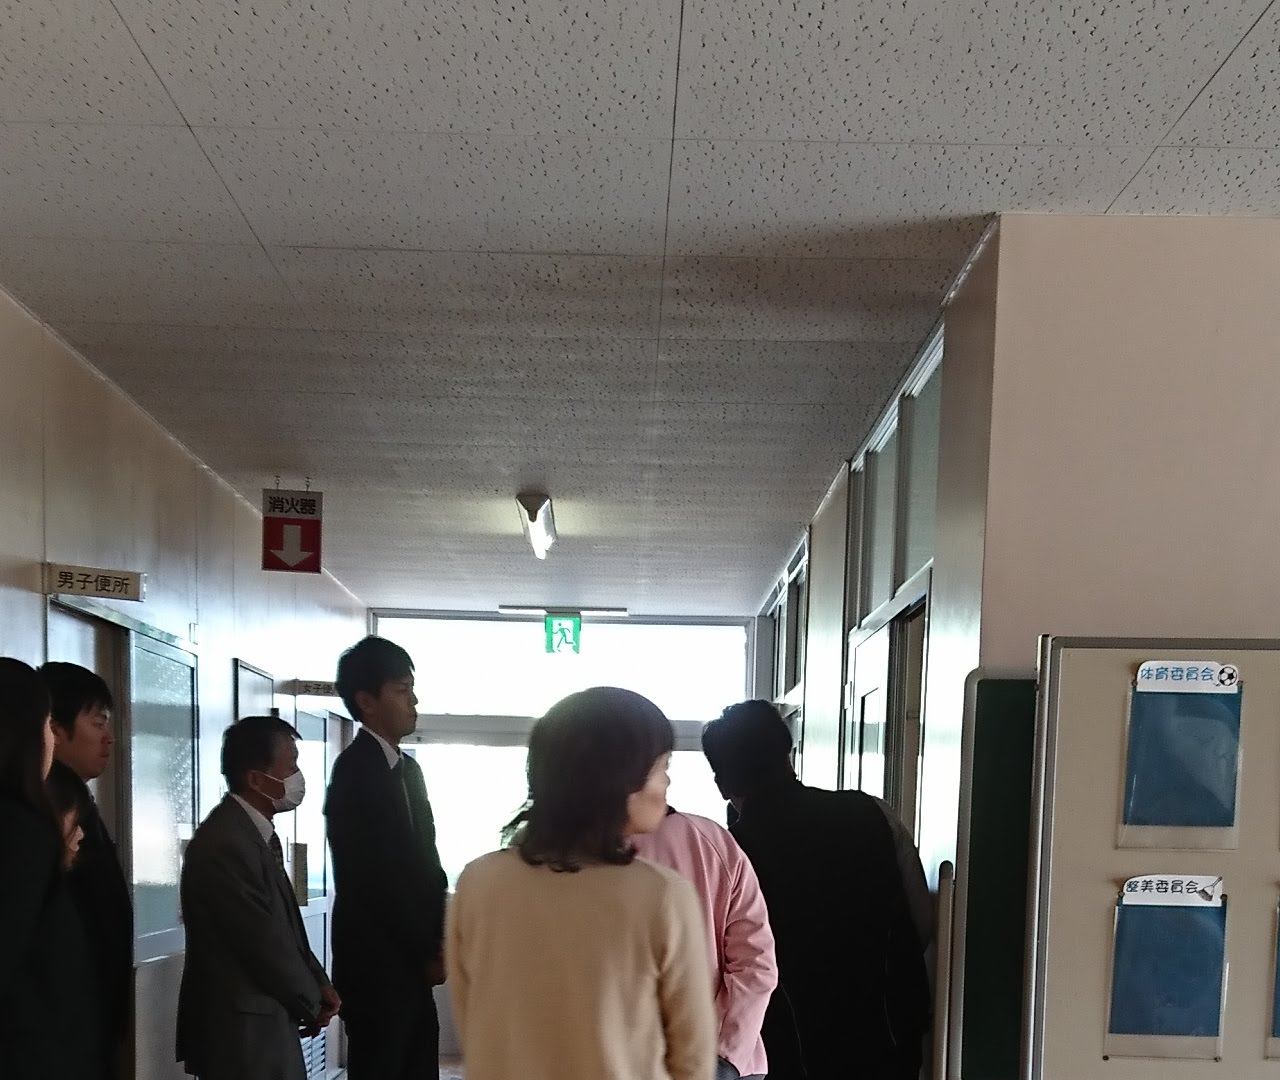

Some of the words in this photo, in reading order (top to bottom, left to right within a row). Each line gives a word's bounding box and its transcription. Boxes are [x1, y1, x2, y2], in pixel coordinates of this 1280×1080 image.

[268, 496, 316, 515] 消火器
[57, 571, 130, 594] 男子便所
[1140, 666, 1214, 681] 体育委員会
[303, 683, 333, 695] 女子便
[1125, 879, 1200, 894] 整美委員会
